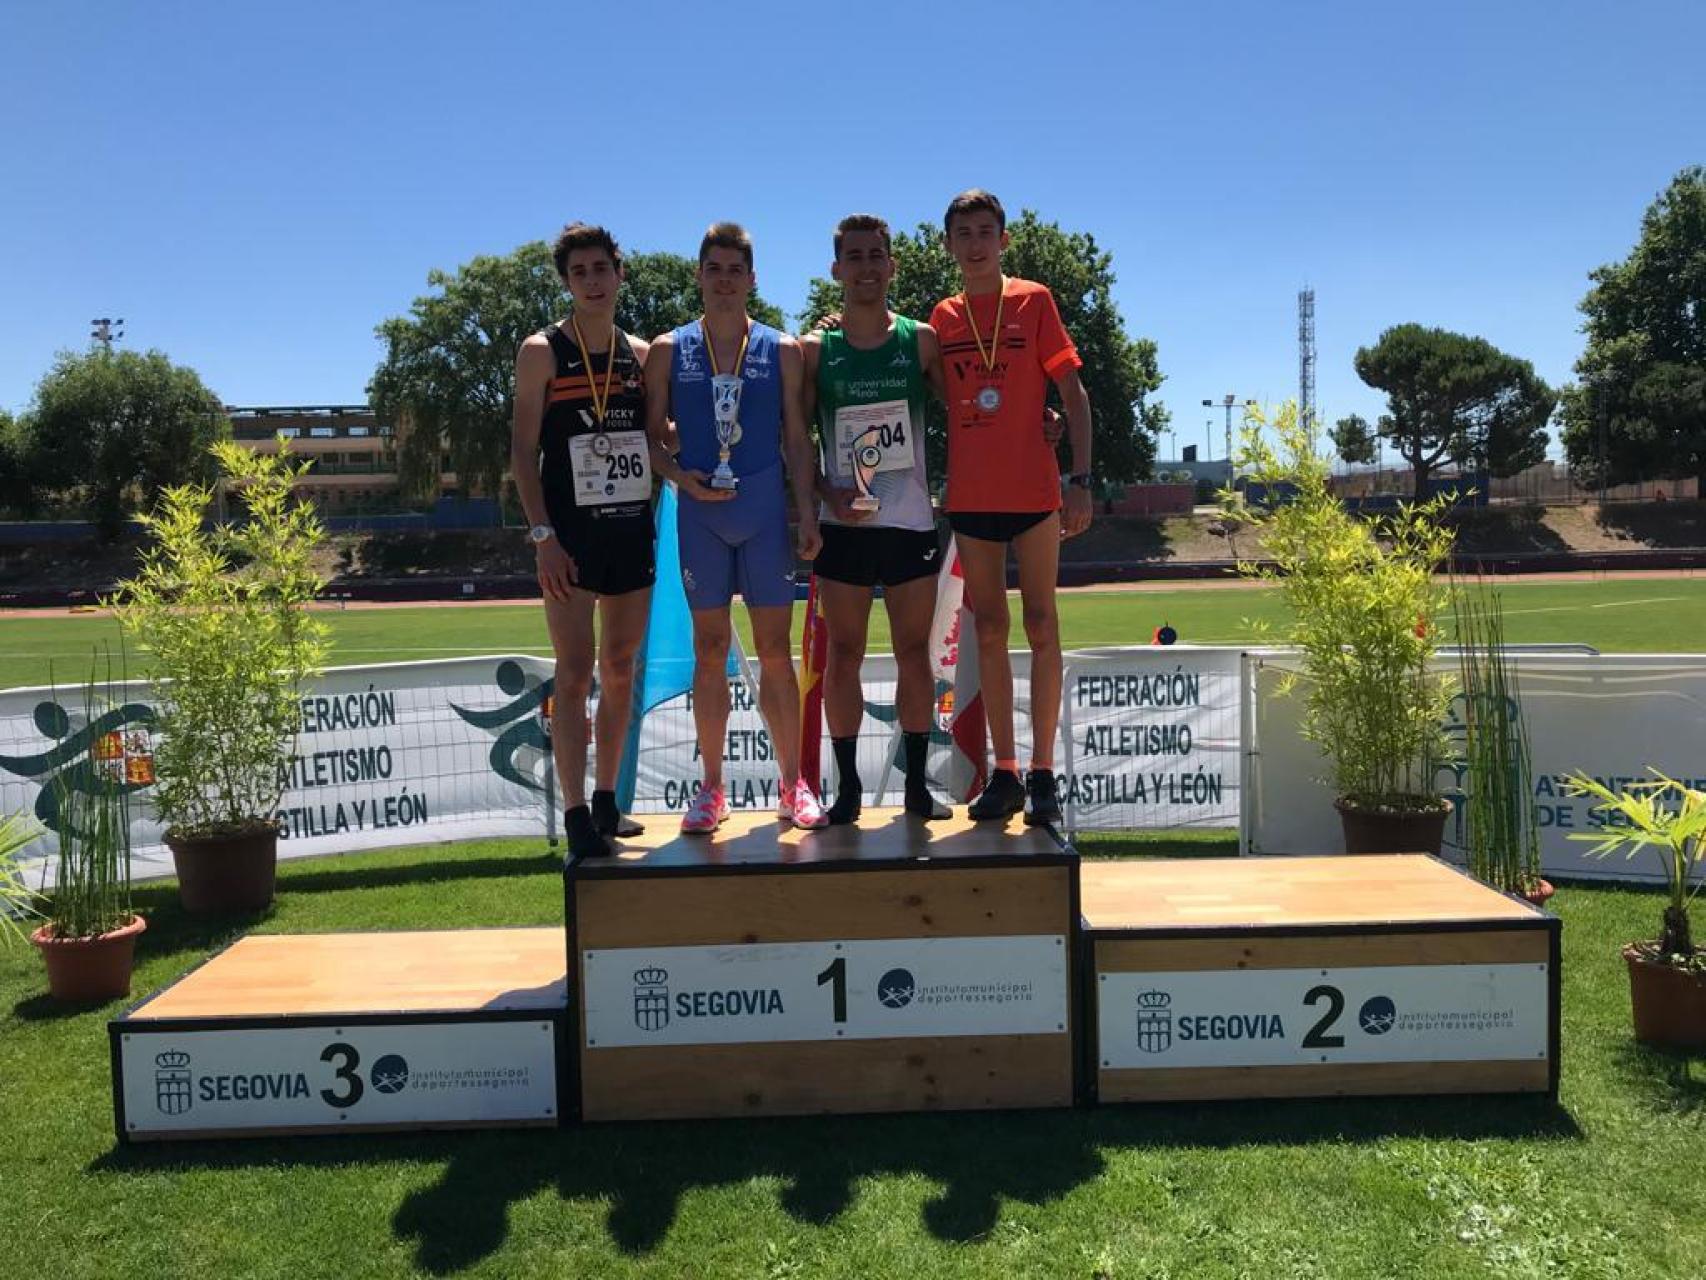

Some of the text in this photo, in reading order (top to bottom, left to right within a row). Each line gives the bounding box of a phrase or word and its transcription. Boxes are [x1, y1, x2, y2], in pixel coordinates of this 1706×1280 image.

[606, 453, 644, 481] 296
[1077, 665, 1200, 707] FEDERACIÓN
[301, 684, 396, 733] ERACIÓN
[1084, 724, 1192, 756] ATLETISMO
[759, 779, 774, 808] Y
[1056, 765, 1222, 805] CASTILLA Y LEÓN
[352, 799, 366, 831] Y
[371, 787, 428, 829] LEÓN
[1534, 805, 1574, 828] DE
[674, 958, 848, 1023] SEGOVIA 1
[1177, 984, 1346, 1049] SEGOVIA 2
[198, 1043, 364, 1108] SEGOVIA 3
